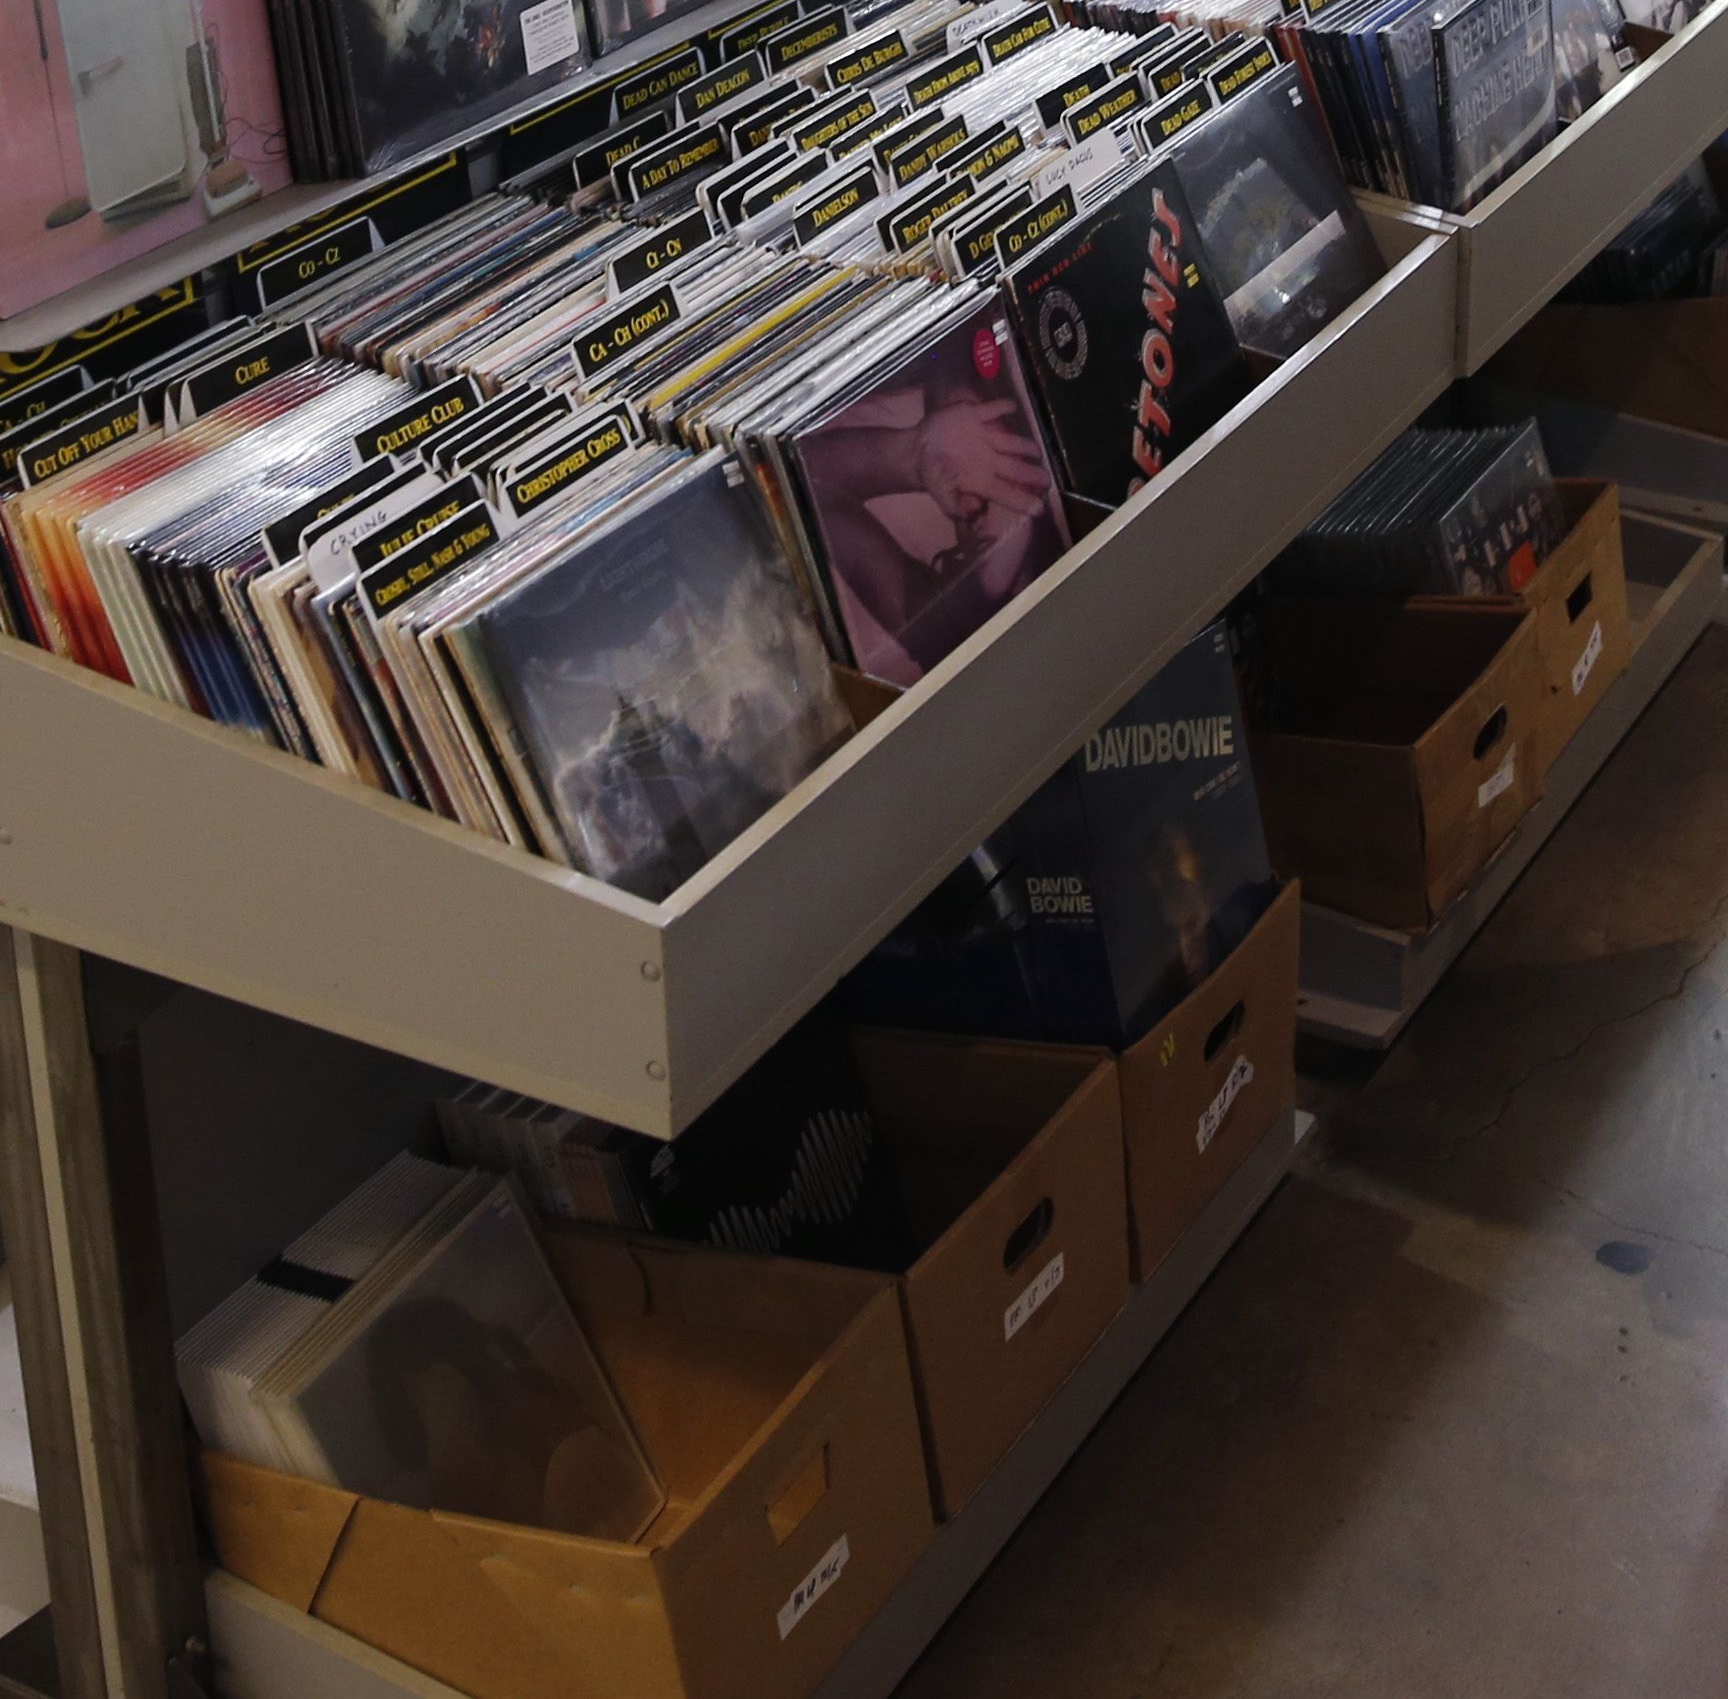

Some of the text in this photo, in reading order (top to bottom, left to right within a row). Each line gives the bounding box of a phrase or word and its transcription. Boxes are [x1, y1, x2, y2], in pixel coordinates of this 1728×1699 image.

[780, 22, 839, 62] DECEMBERISTS
[836, 40, 905, 85] CHRIS DE BURGH
[622, 62, 699, 111] DEAD CAN DANCE
[695, 68, 751, 109] DAN DEACON
[913, 84, 936, 106] DEATH
[933, 76, 951, 95] FROM
[948, 67, 968, 86] ABOVE
[1453, 49, 1546, 143] MACHINE HEAD
[1076, 87, 1138, 136] DEAD WEATHER
[1159, 98, 1202, 137] DEAD GAZE
[642, 137, 720, 190] A DAY TO REMEMBER
[898, 154, 928, 183] DANDY
[925, 127, 966, 164] WARHOLS
[984, 148, 994, 168] &
[993, 134, 1020, 161] NAOMI
[811, 186, 861, 228] DANIELSON
[1008, 234, 1023, 253] CO
[1027, 221, 1040, 242] CZ
[1039, 201, 1069, 234] (CONT.)
[901, 215, 932, 246] ROGER
[298, 257, 316, 280] CO
[325, 245, 341, 266] CZ
[588, 341, 609, 364] CA
[613, 327, 633, 349] CH
[631, 300, 670, 338] (CONT.)
[235, 355, 271, 387] CURE
[375, 397, 465, 455] CULTURE CLUB
[34, 452, 59, 480] CUT
[58, 438, 81, 468] OFF
[79, 423, 114, 455] YOUR
[516, 427, 622, 504] CHRISTOPHER CROSS
[330, 510, 388, 556] CRYING
[375, 578, 411, 607] CROSBY,
[432, 544, 456, 572] NASH
[452, 535, 464, 556] &
[460, 522, 491, 552] YOUNG
[1084, 715, 1235, 773] DAVIDBOWIE
[1026, 875, 1083, 896] DAVID
[1029, 894, 1095, 915] BOWIE
